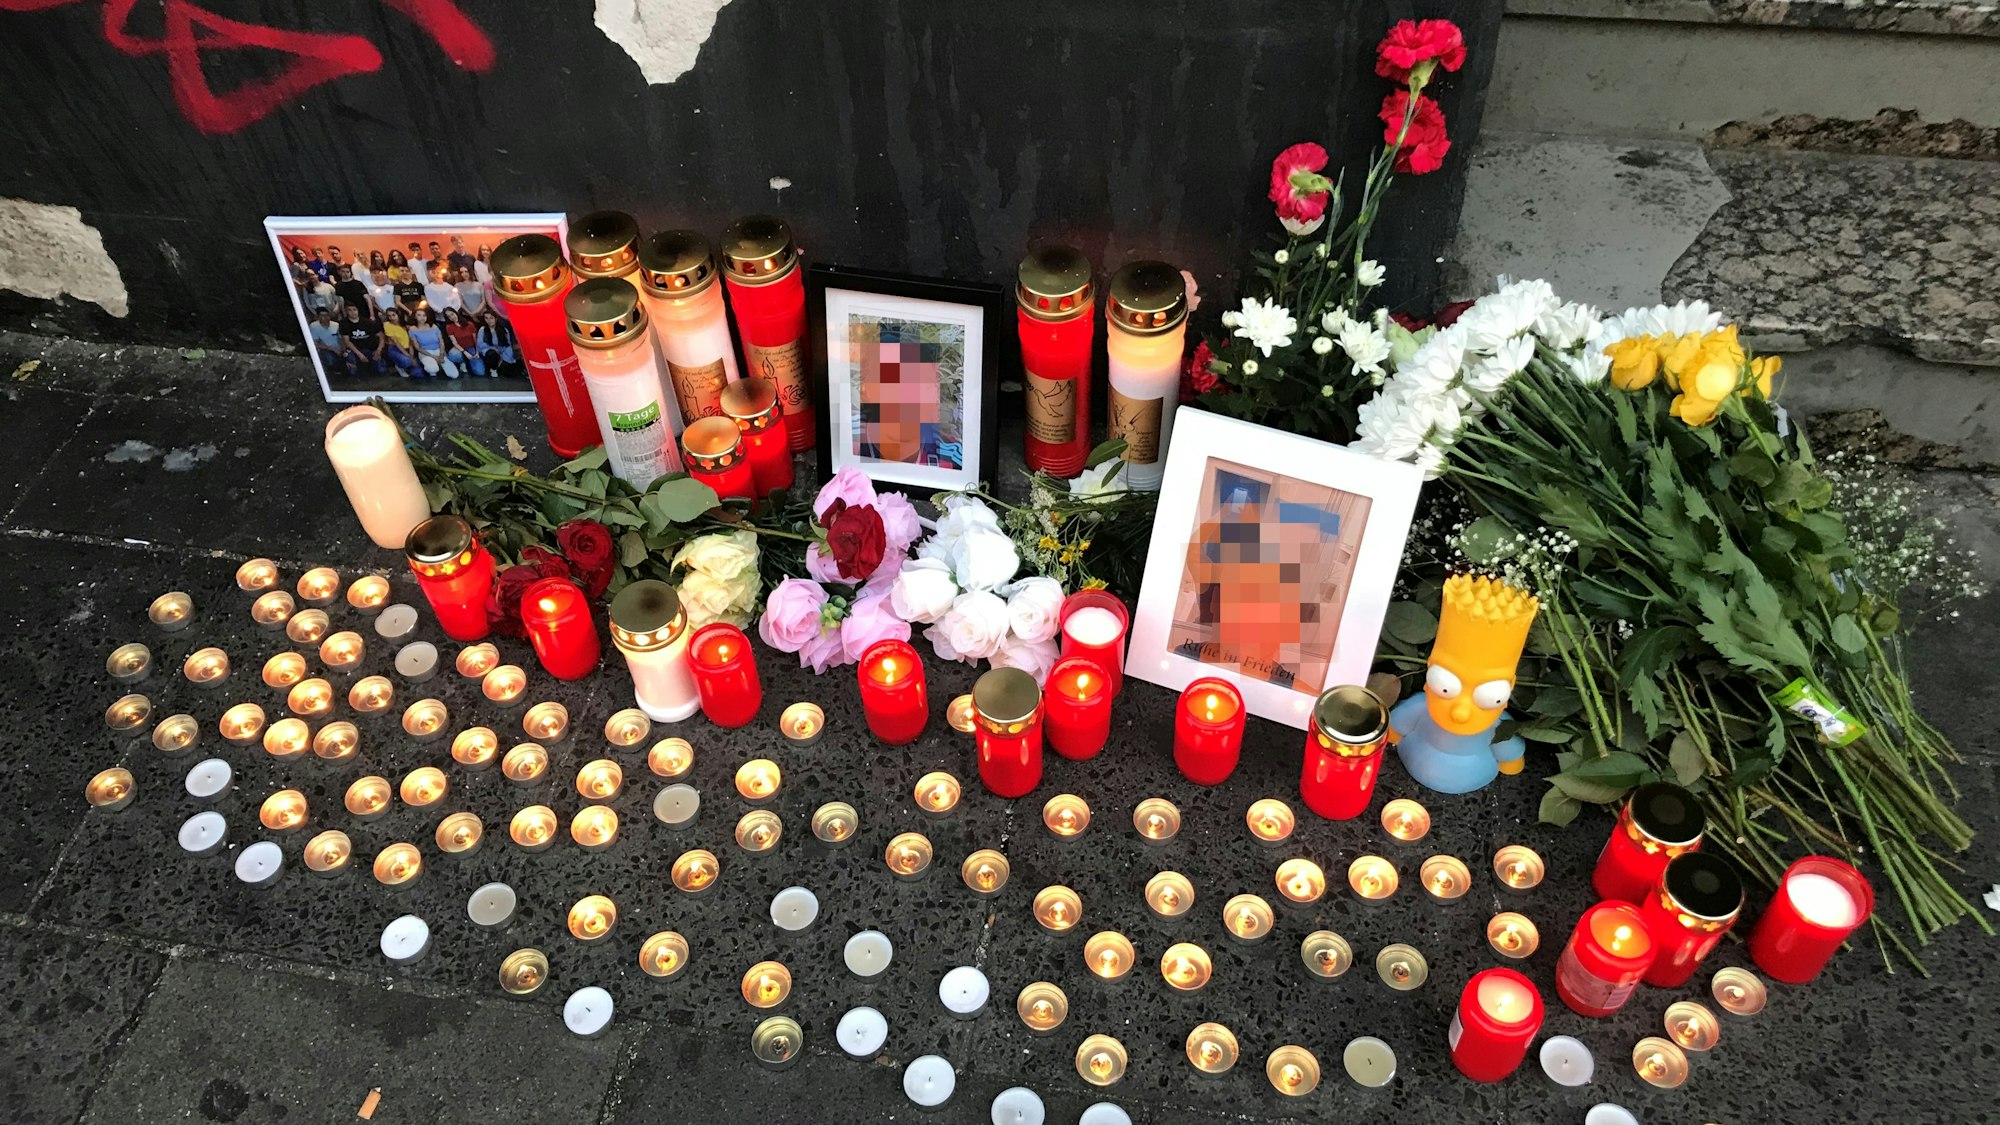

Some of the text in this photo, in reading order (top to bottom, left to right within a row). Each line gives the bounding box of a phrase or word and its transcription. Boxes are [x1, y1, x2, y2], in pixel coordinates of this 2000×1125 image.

[613, 406, 655, 422] 7 Tage
[1182, 638, 1296, 680] Ruhe in Frieden
